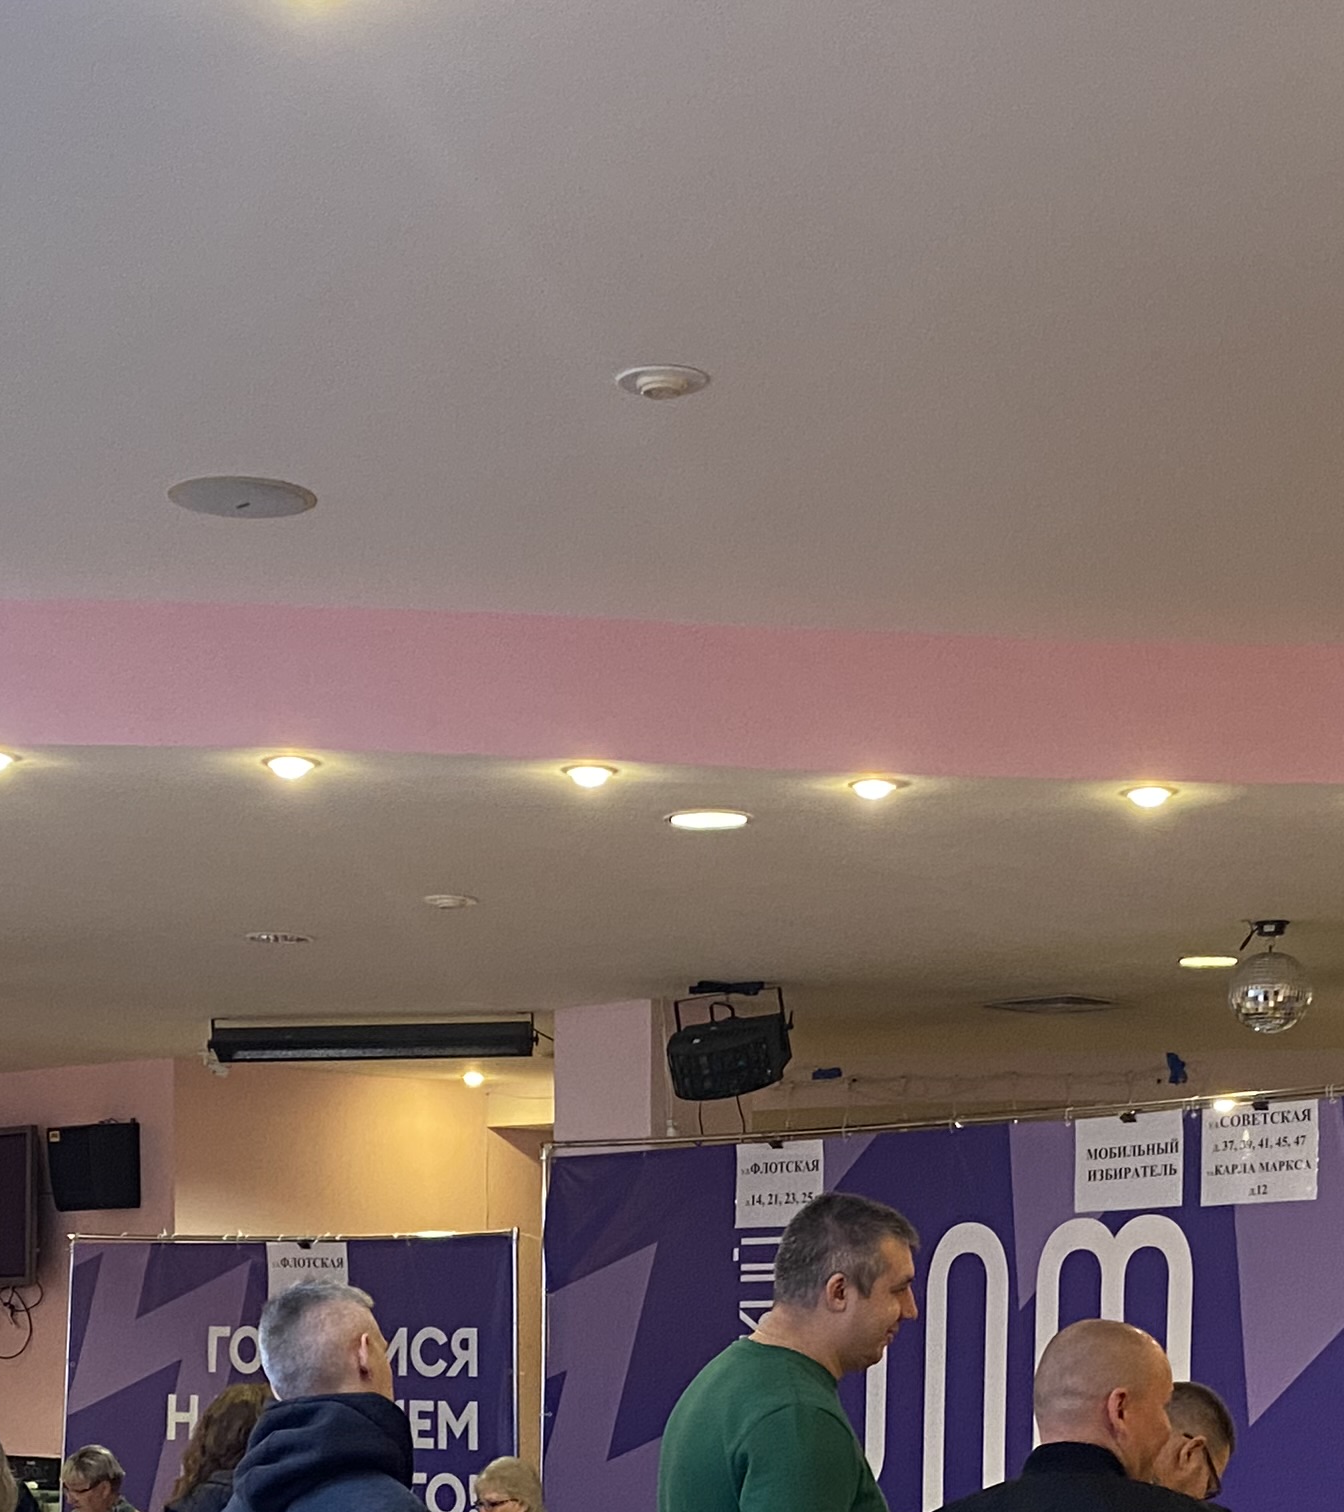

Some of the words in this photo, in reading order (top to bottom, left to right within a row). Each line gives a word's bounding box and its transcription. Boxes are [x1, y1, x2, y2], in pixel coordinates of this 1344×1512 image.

[1293, 1135, 1307, 1146] 47
[1086, 1138, 1179, 1161] МОБИЛЬНЫЙ
[1087, 1163, 1178, 1182] ИЗБИРАТЕЛЬ
[1258, 1159, 1312, 1173] МАРКСА
